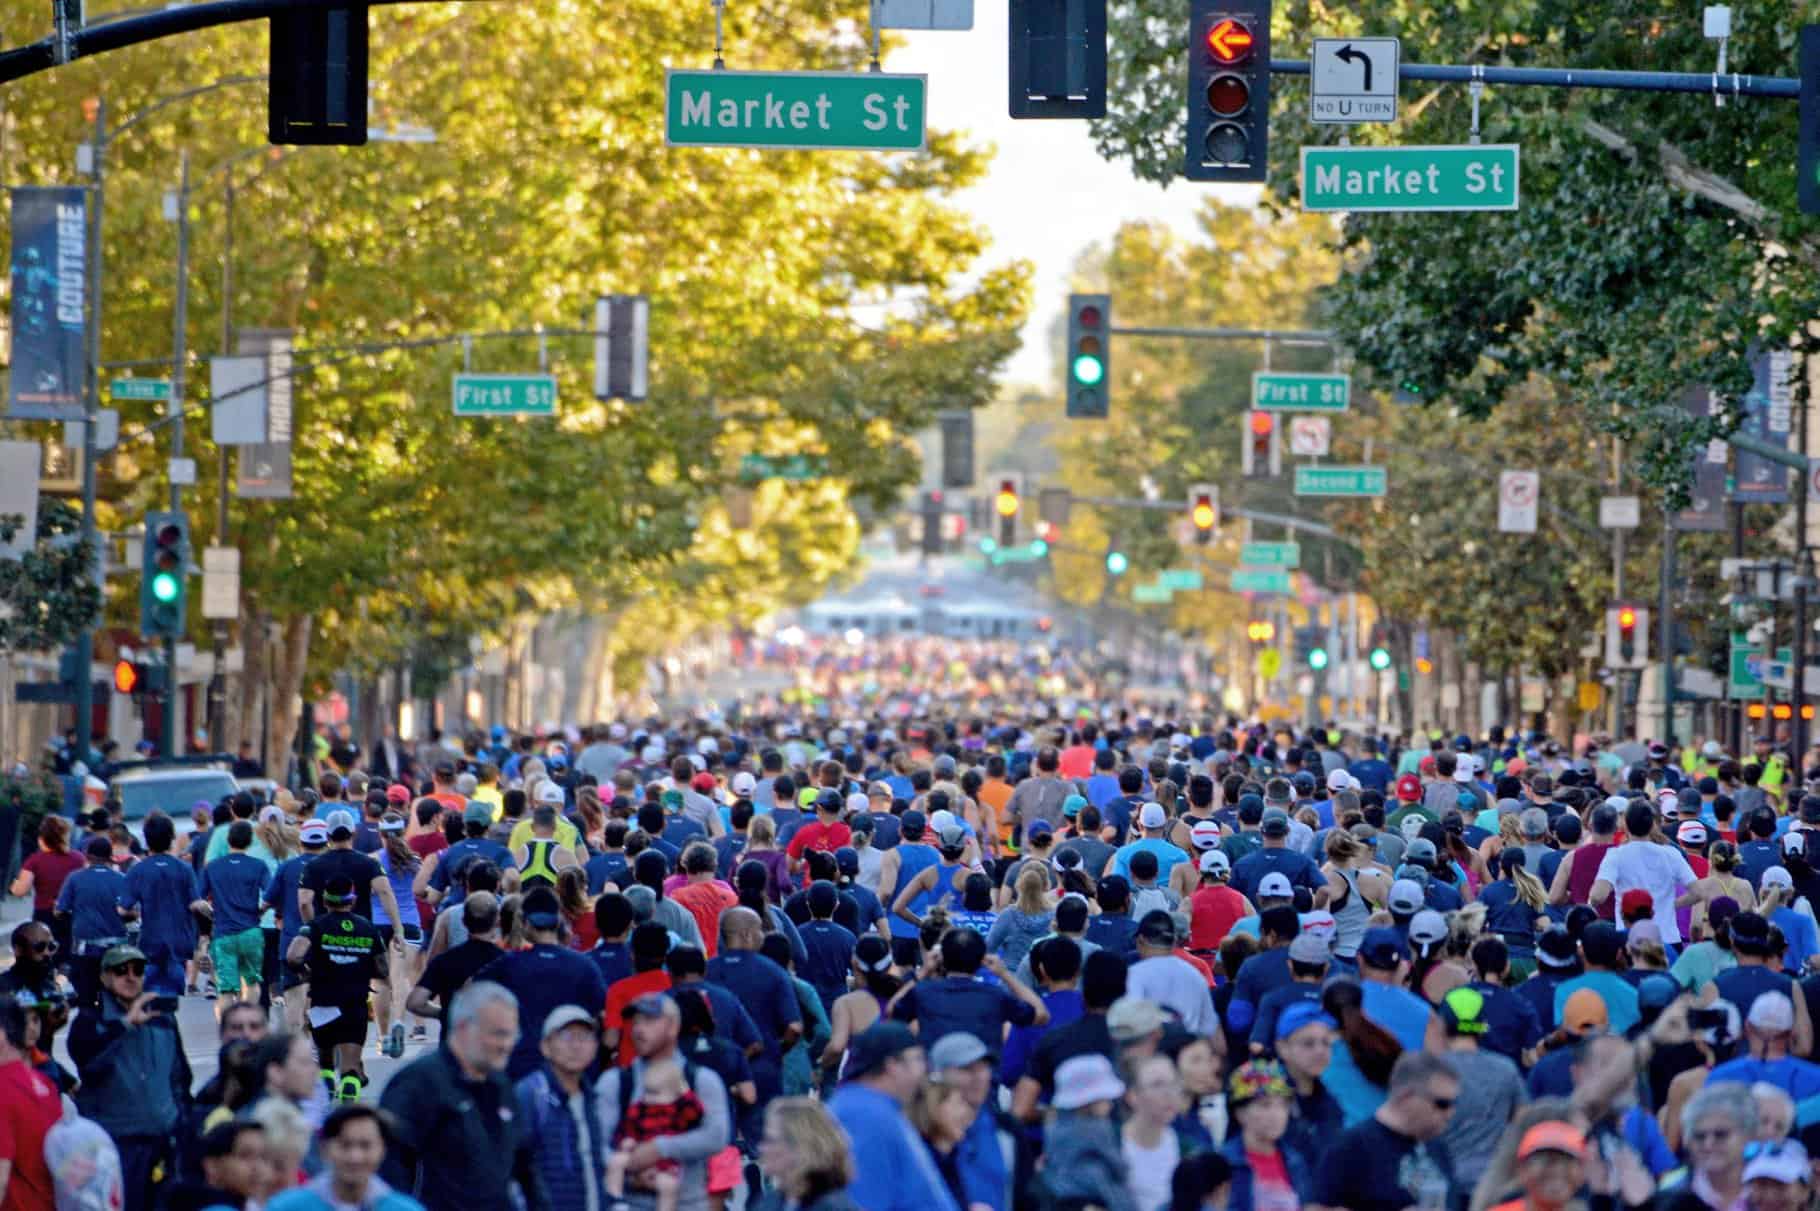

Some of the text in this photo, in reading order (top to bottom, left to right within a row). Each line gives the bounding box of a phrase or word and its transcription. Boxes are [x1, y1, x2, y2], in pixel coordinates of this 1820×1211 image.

[681, 90, 910, 131] Market St
[1316, 99, 1392, 116] NO U TURN
[1315, 162, 1505, 194] Market St
[56, 203, 84, 322] COUTURE
[460, 385, 551, 405] First St
[1259, 382, 1345, 403] First St
